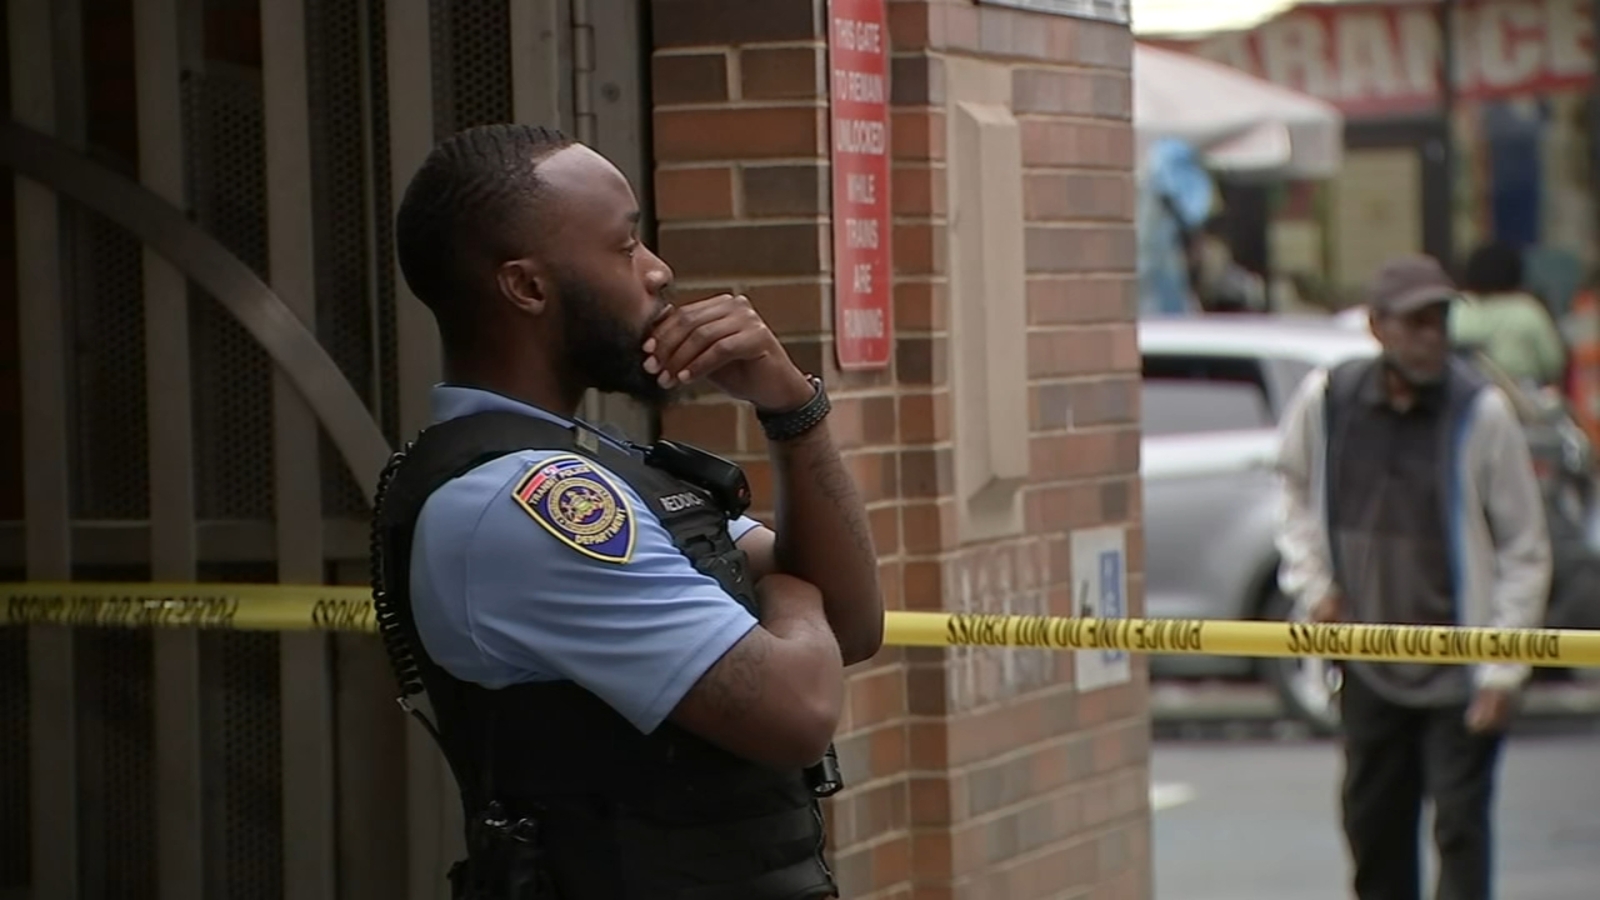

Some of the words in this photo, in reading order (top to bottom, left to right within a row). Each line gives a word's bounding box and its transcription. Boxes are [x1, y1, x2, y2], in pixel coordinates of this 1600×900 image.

[834, 17, 855, 51] THIS
[856, 20, 880, 54] GATE
[834, 69, 847, 101] TO
[848, 71, 884, 105] REMAIN
[835, 117, 884, 155] UNLOCKED
[846, 173, 876, 205] WHILE
[845, 218, 879, 250] TRAINS
[853, 262, 872, 294] ARE
[843, 308, 884, 339] RUNNING
[529, 473, 561, 506] TRANSIT
[559, 465, 591, 479] POLICE
[574, 507, 627, 545] DEPARTMENT
[946, 613, 1007, 645] CROSS
[1014, 614, 1051, 647] NOT
[1054, 616, 1082, 648] DO
[1088, 617, 1130, 649] LINE
[1135, 619, 1201, 651] POLICE
[1288, 623, 1354, 654] CROSS
[1360, 624, 1399, 654] NOT
[1404, 626, 1432, 655] DO
[1439, 627, 1482, 656] LINE
[1490, 629, 1559, 658] POLICE
